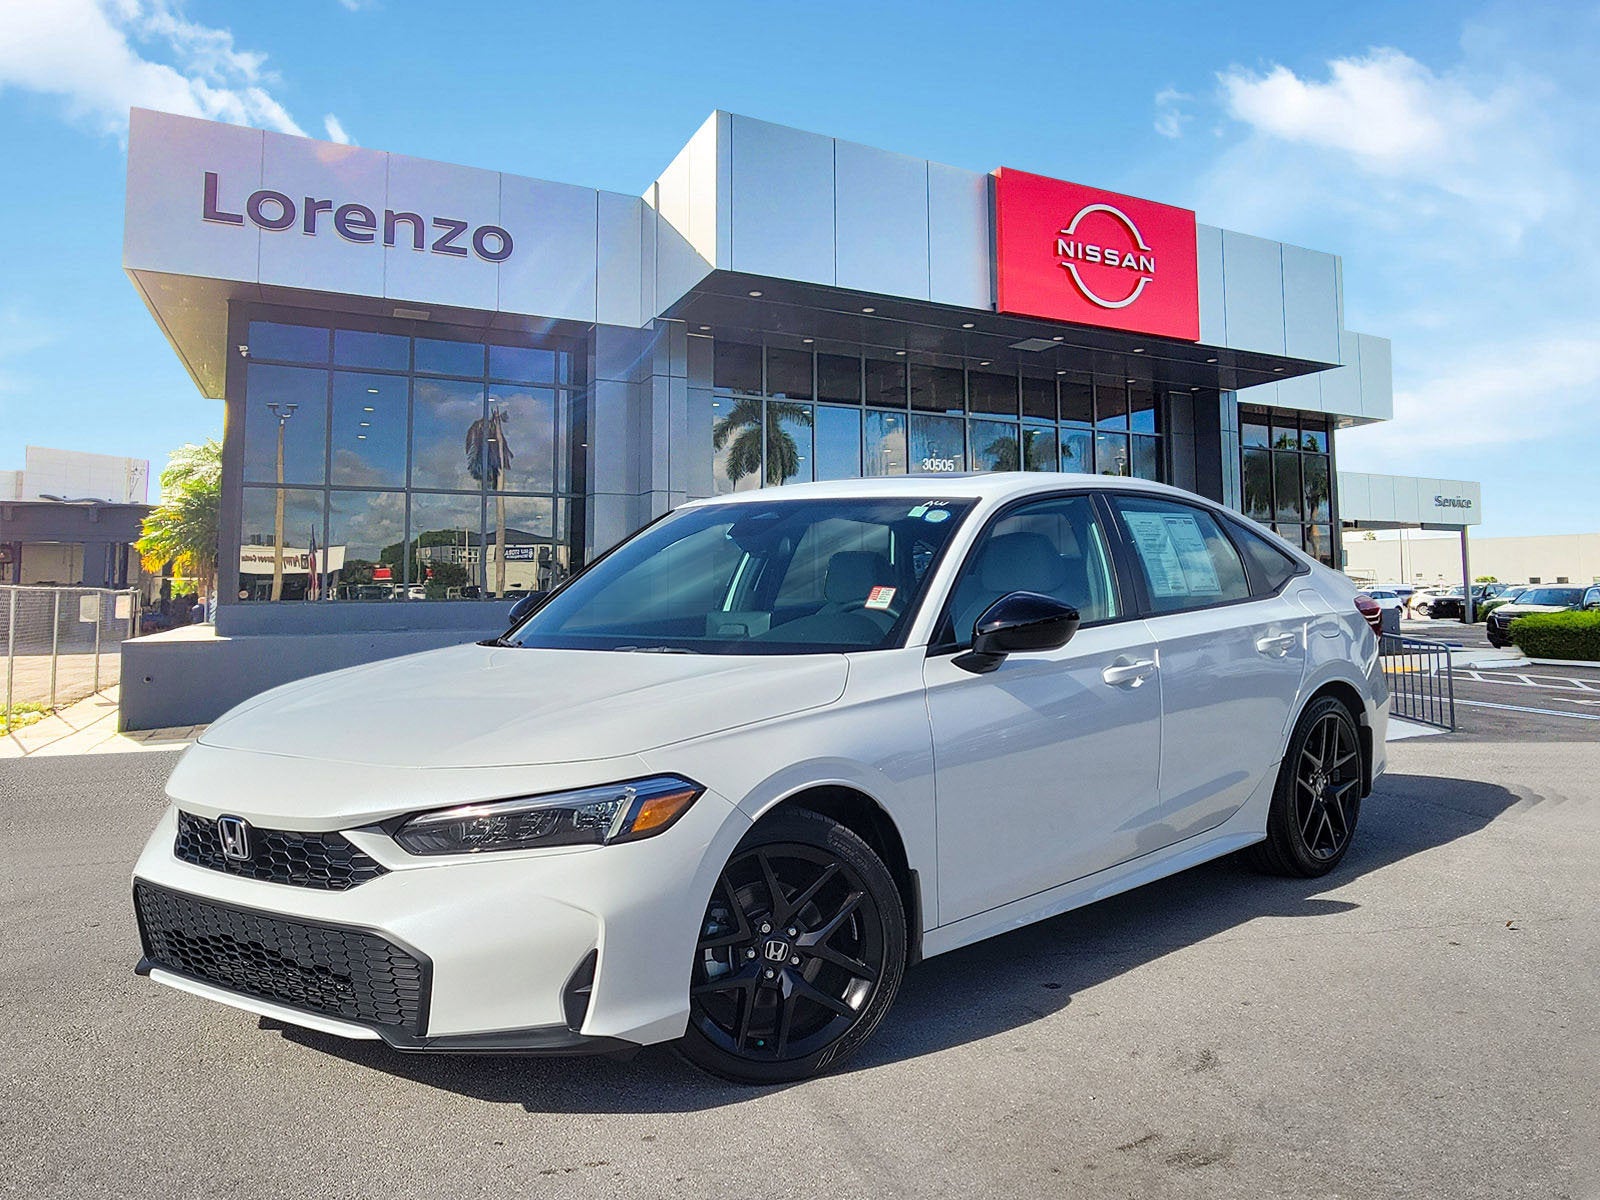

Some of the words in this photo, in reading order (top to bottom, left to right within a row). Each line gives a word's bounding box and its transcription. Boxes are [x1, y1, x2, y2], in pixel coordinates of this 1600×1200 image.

[202, 171, 514, 263] Lorenzo
[1057, 238, 1155, 273] NISSAN
[922, 457, 955, 472] 30505
[1434, 495, 1472, 509] Service
